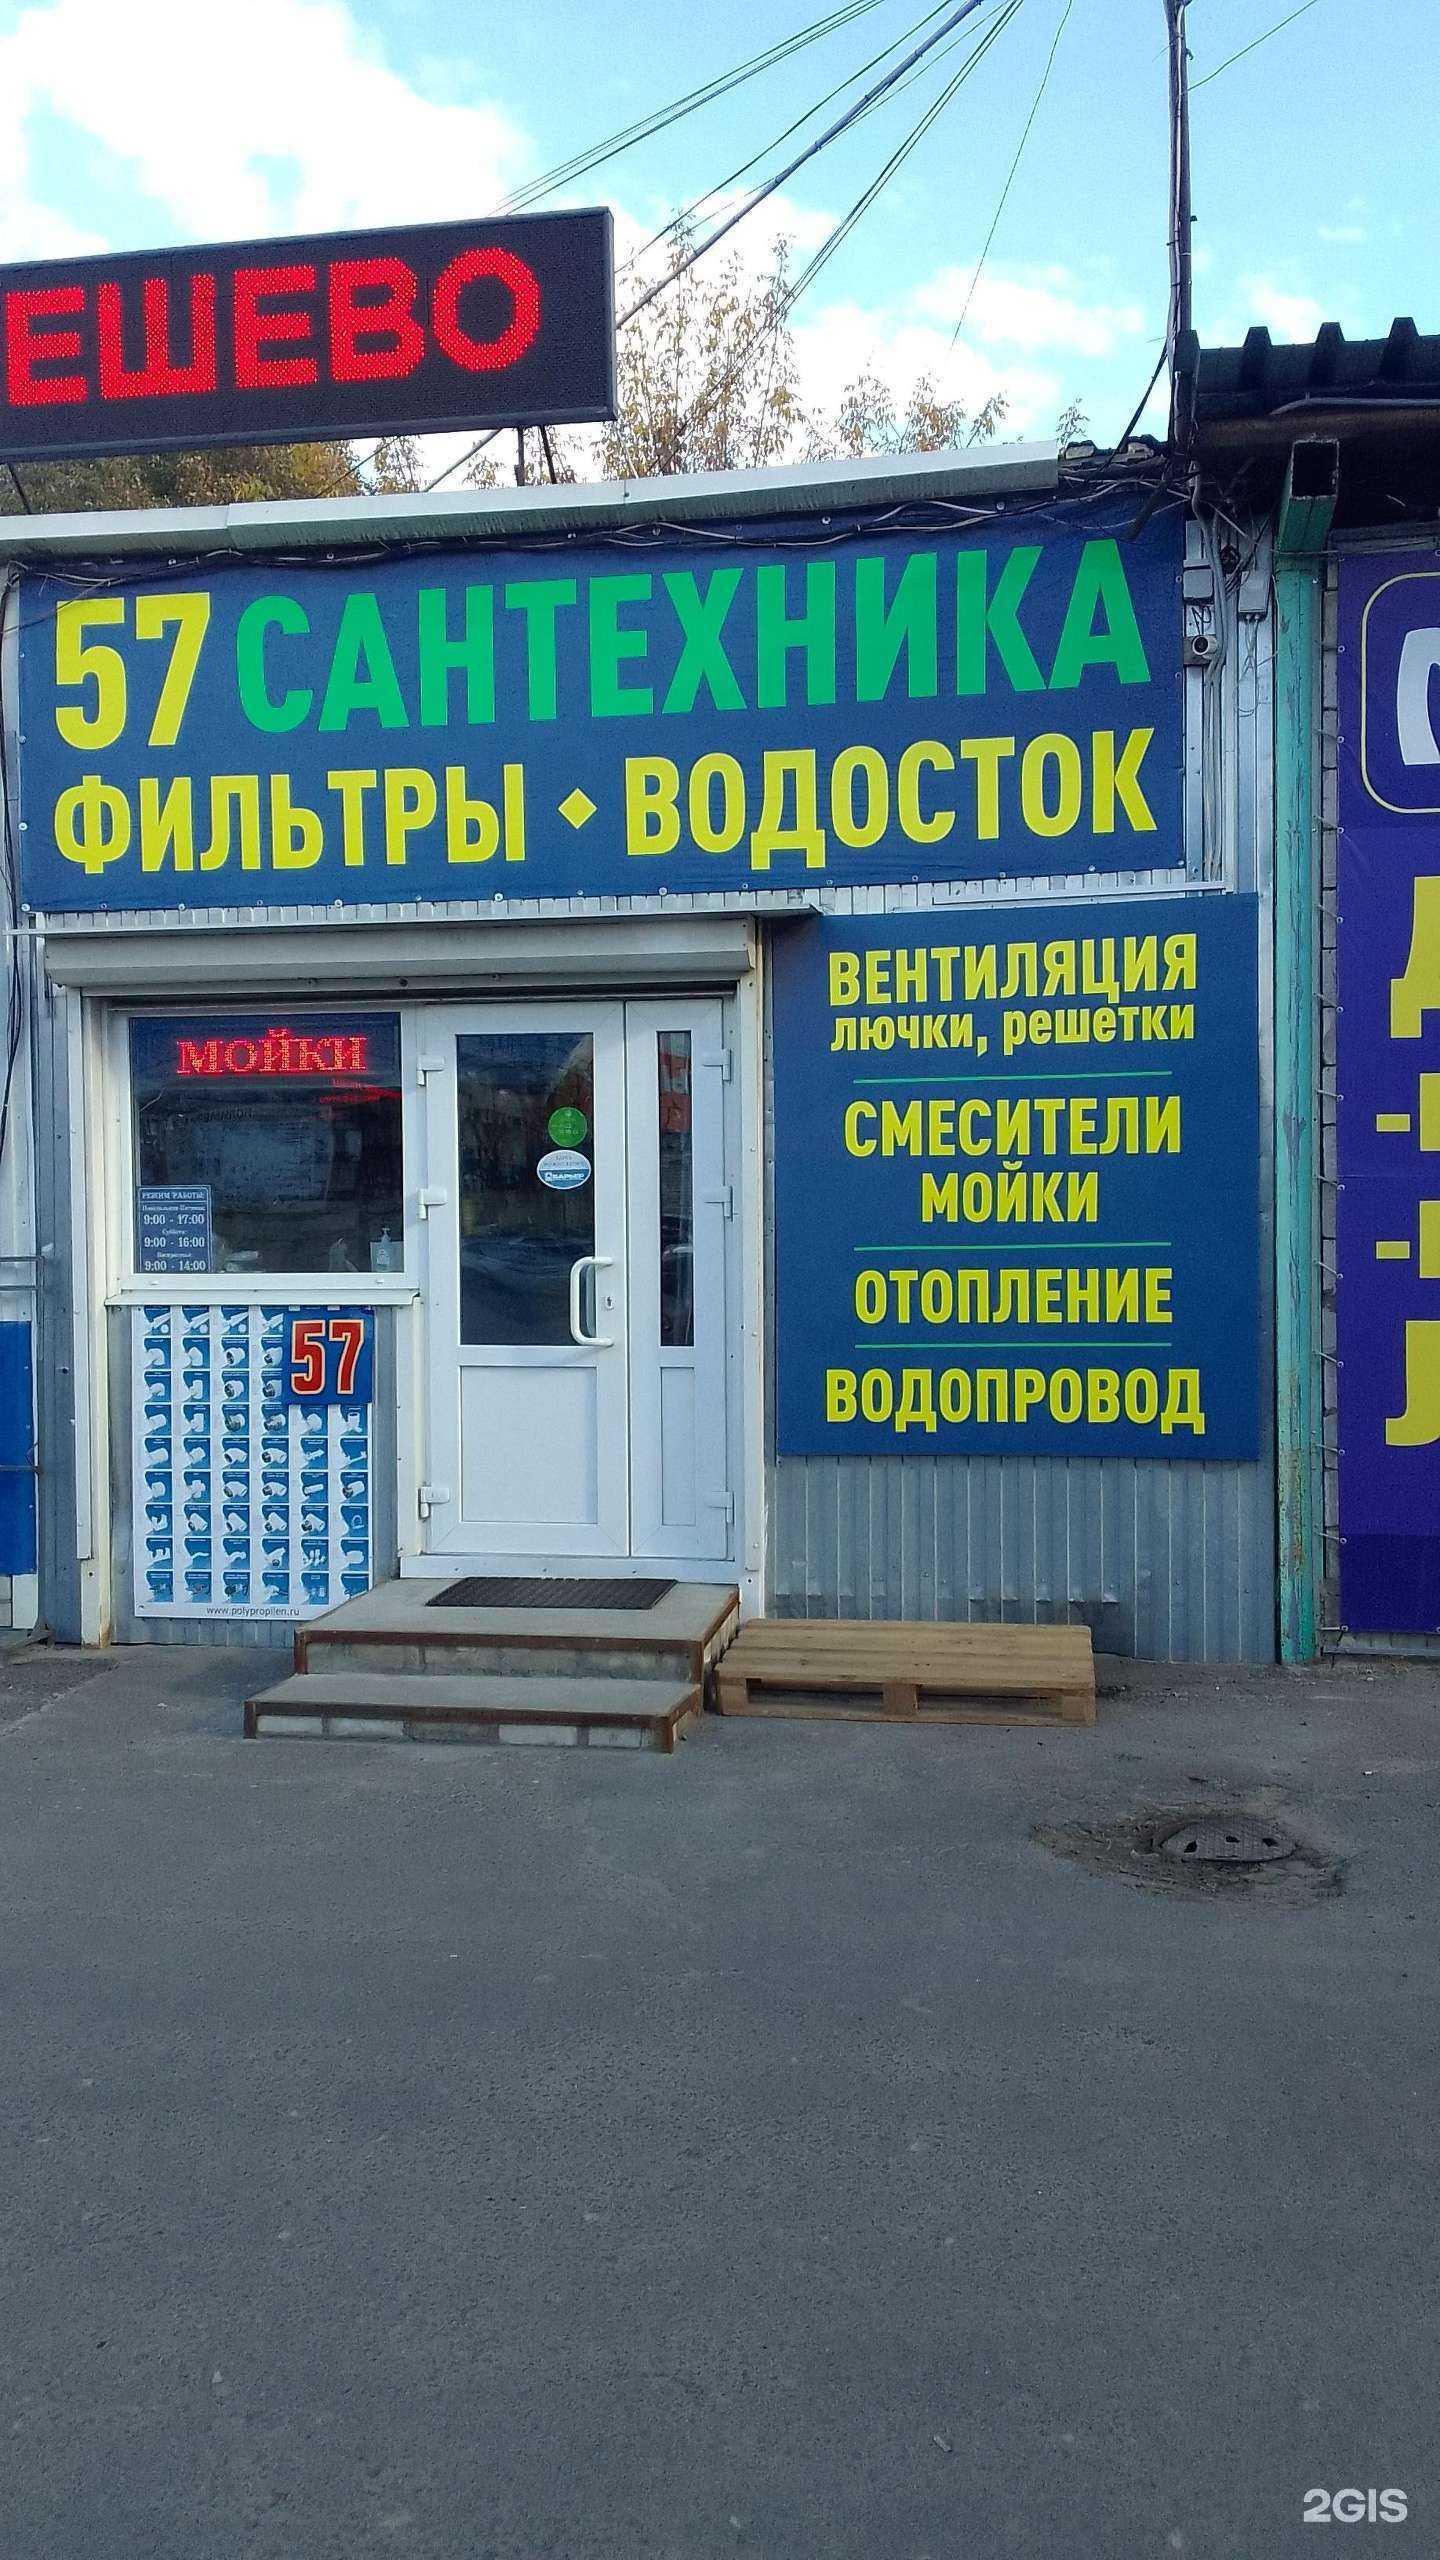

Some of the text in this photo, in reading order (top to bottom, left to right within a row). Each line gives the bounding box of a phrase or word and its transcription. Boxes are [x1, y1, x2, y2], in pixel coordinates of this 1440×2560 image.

[5, 246, 542, 407] ЕШЕВО
[55, 537, 1152, 750] 57 САНТЕХНИКА
[53, 727, 1158, 875] ФИЛЬТРЫ ВОДОСТОК
[829, 933, 1197, 1006] ВЕНТИЛЯЦИЯ
[176, 1027, 367, 1075] МОЙКИ
[830, 1003, 1195, 1058] лючки, решетки
[843, 1095, 1182, 1158] СМЕСИТЕЛИ
[143, 1214, 166, 1225] 9:00
[177, 1213, 205, 1225] 17:00
[920, 1160, 1099, 1224] МОЙКИ
[144, 1236, 166, 1248] 9:00
[178, 1236, 205, 1248] 16:00
[145, 1260, 167, 1271] 9:00
[179, 1260, 206, 1271] 14:00
[853, 1266, 1174, 1326] ОТОПЛЕНИЕ
[291, 1319, 364, 1395] 57
[824, 1366, 1207, 1436] ВОДОПРОВОД
[206, 1606, 300, 1617] www.polypropilen.ru
